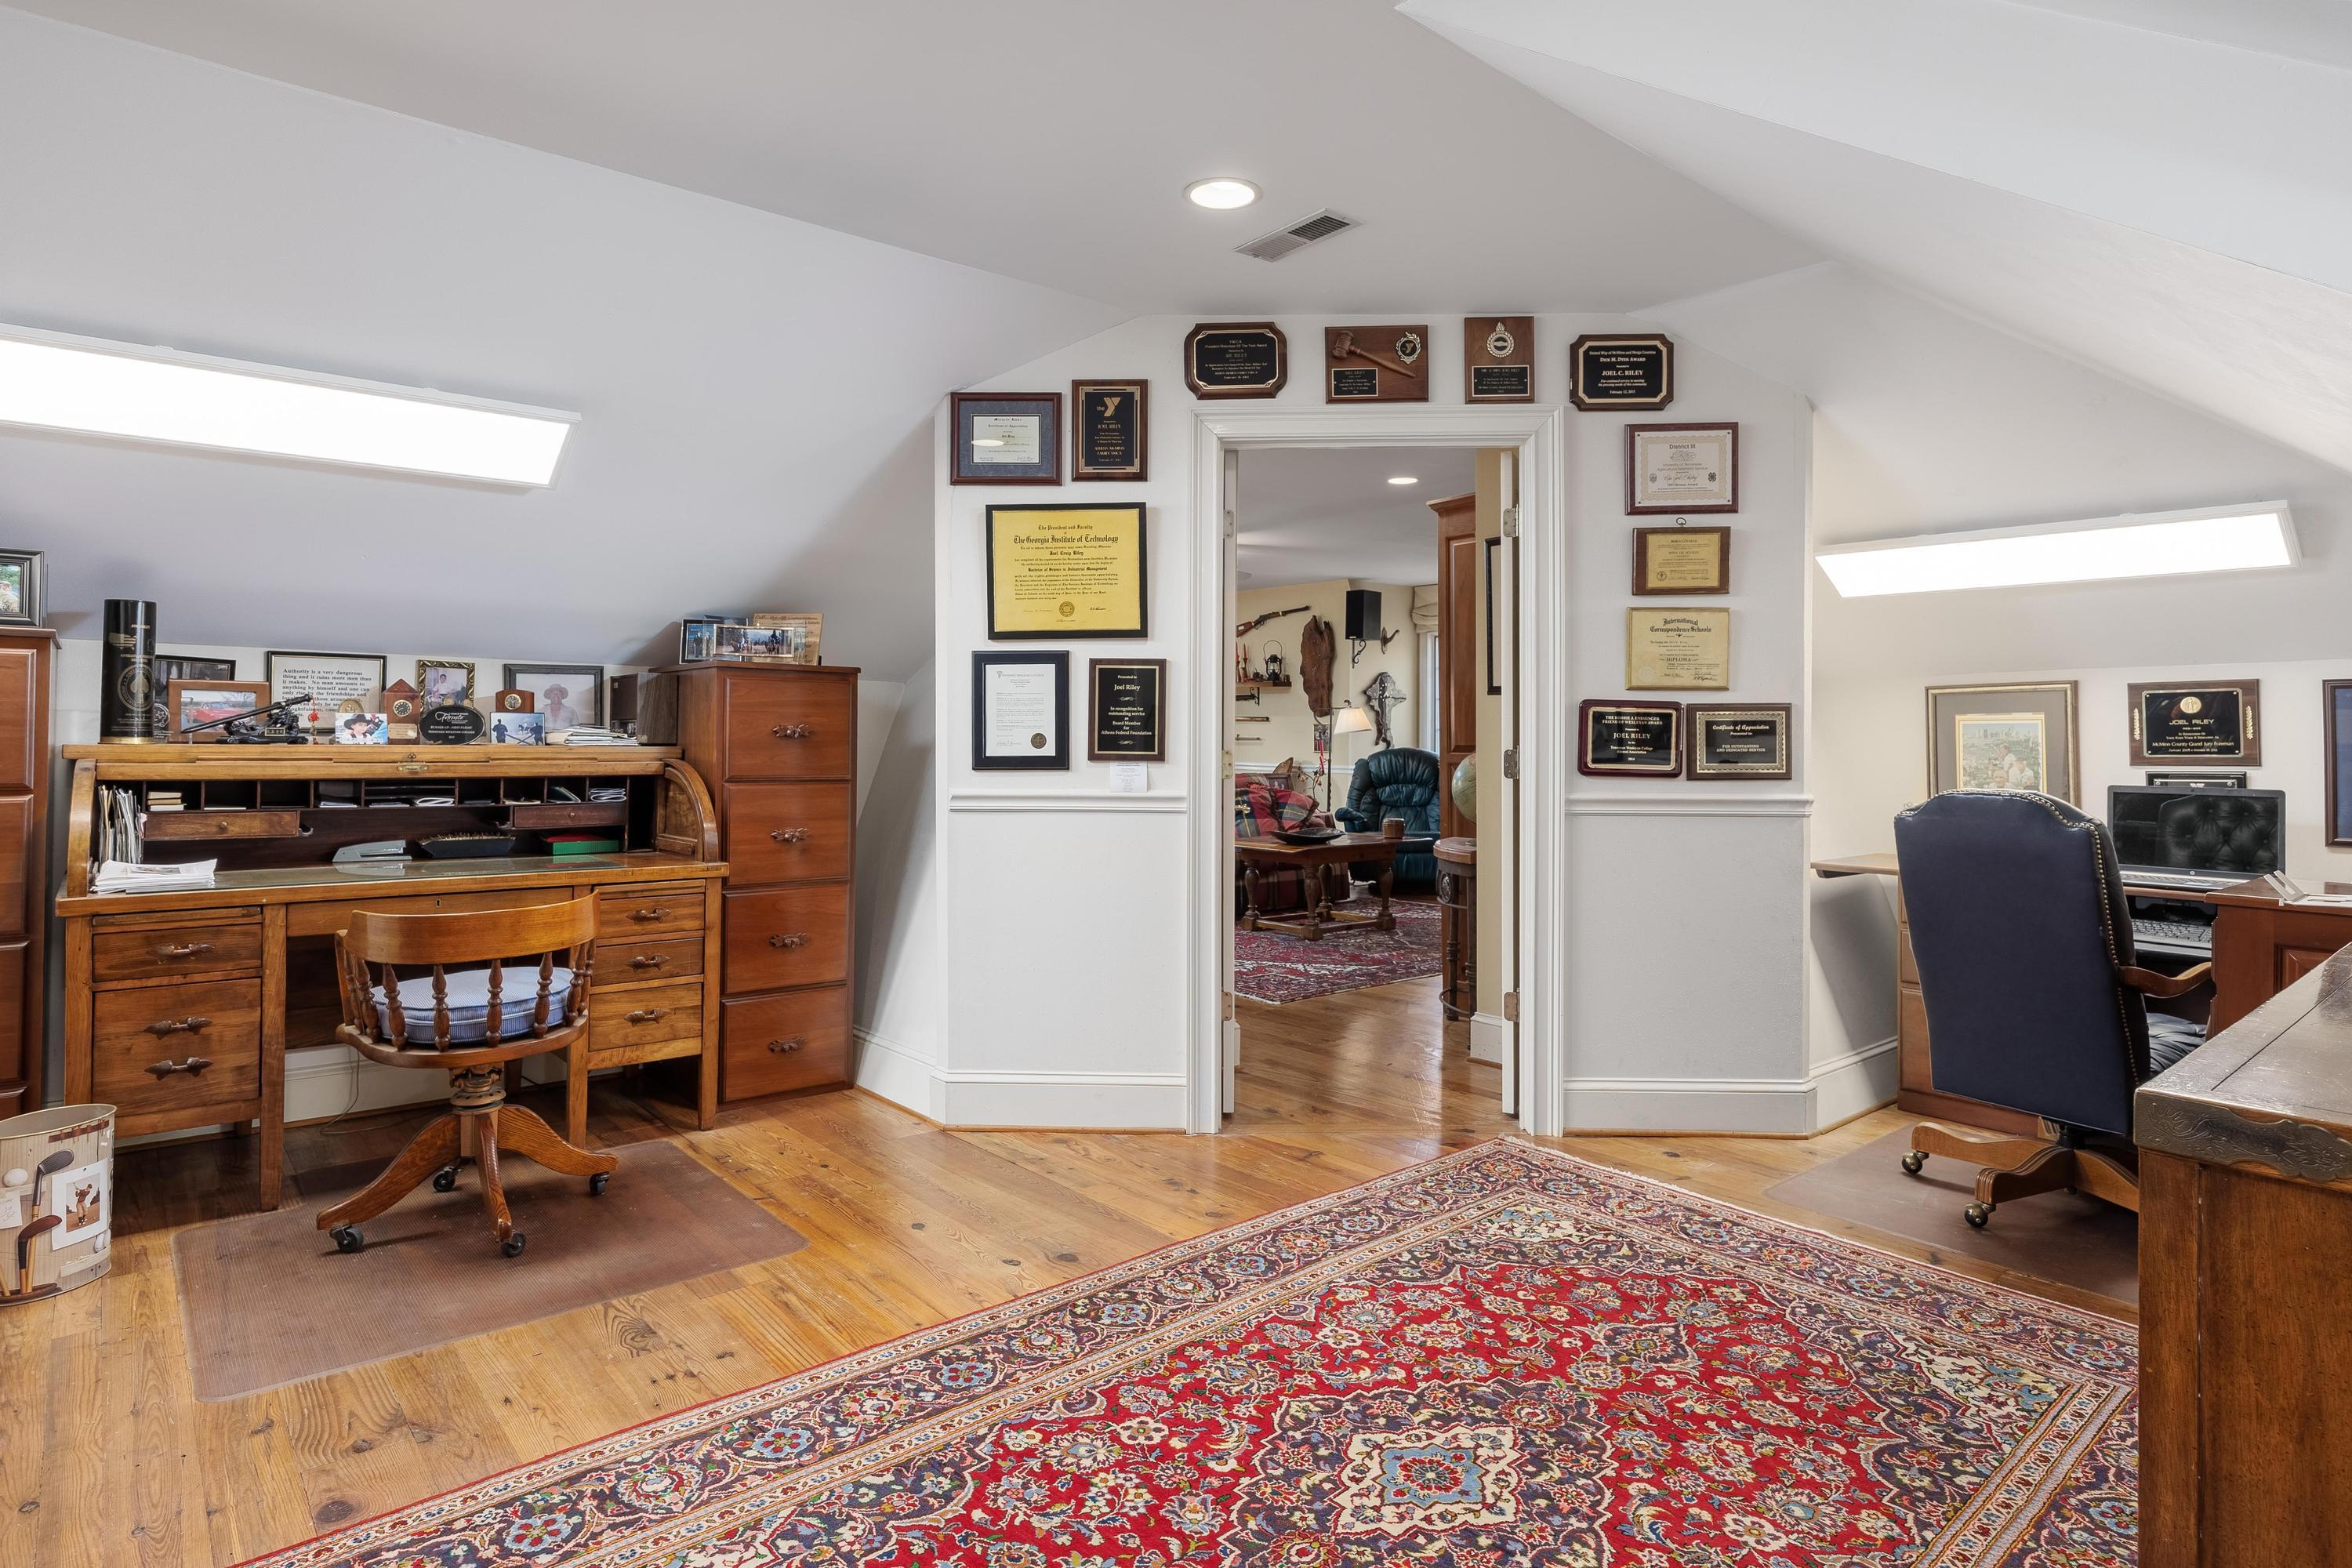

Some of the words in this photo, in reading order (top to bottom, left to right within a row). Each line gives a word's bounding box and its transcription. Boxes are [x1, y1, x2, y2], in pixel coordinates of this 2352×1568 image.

[1104, 397, 1121, 416] Y
[1014, 535, 1025, 544] The
[1026, 535, 1050, 545] Georgia
[1051, 534, 1076, 543] Institute
[1084, 534, 1119, 543] Technology
[1663, 618, 1698, 626] International
